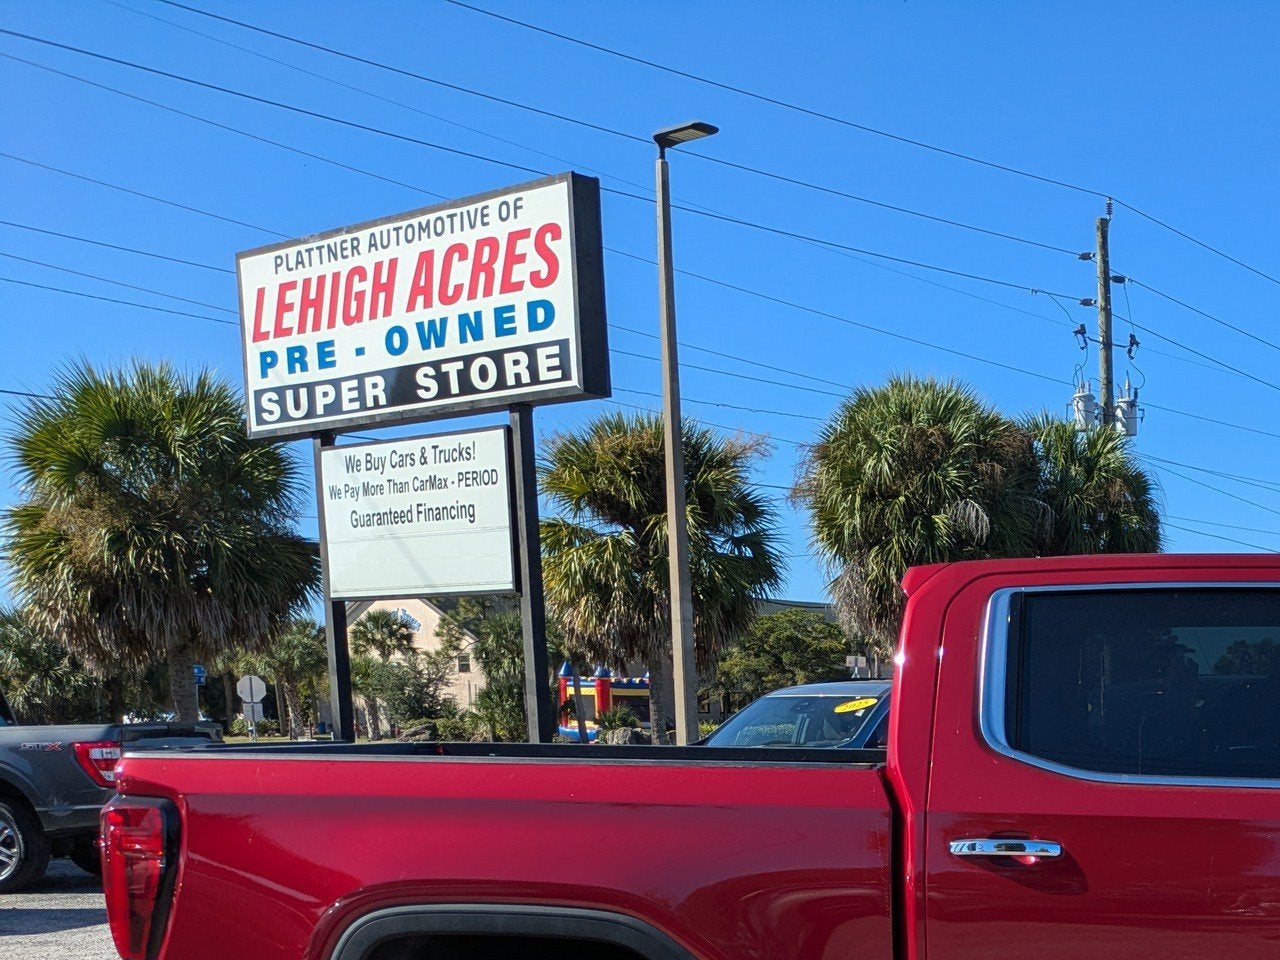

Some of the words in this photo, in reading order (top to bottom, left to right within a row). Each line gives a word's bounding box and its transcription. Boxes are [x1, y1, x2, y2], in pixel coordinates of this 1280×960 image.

[274, 236, 361, 275] PLATTNER
[368, 204, 491, 254] AUTOMOTIVE
[498, 196, 525, 223] OF
[252, 257, 399, 343] LEHIGH
[405, 222, 563, 314] ACRES
[259, 339, 337, 379] PRE
[385, 299, 556, 357] OWNED
[260, 375, 388, 422] SUPER
[415, 345, 563, 400] STORE
[329, 484, 342, 500] We
[344, 482, 360, 501] Pay
[362, 479, 384, 497] More
[386, 477, 410, 495] Than
[412, 474, 449, 492] CarMax
[457, 468, 499, 488] PERIOD
[345, 455, 362, 474] We
[365, 452, 387, 475] Buy
[389, 449, 416, 469] Cars
[419, 446, 428, 466] &
[431, 441, 476, 464] Trucks!
[350, 503, 413, 529] Guaranteed
[416, 500, 476, 524] Financing
